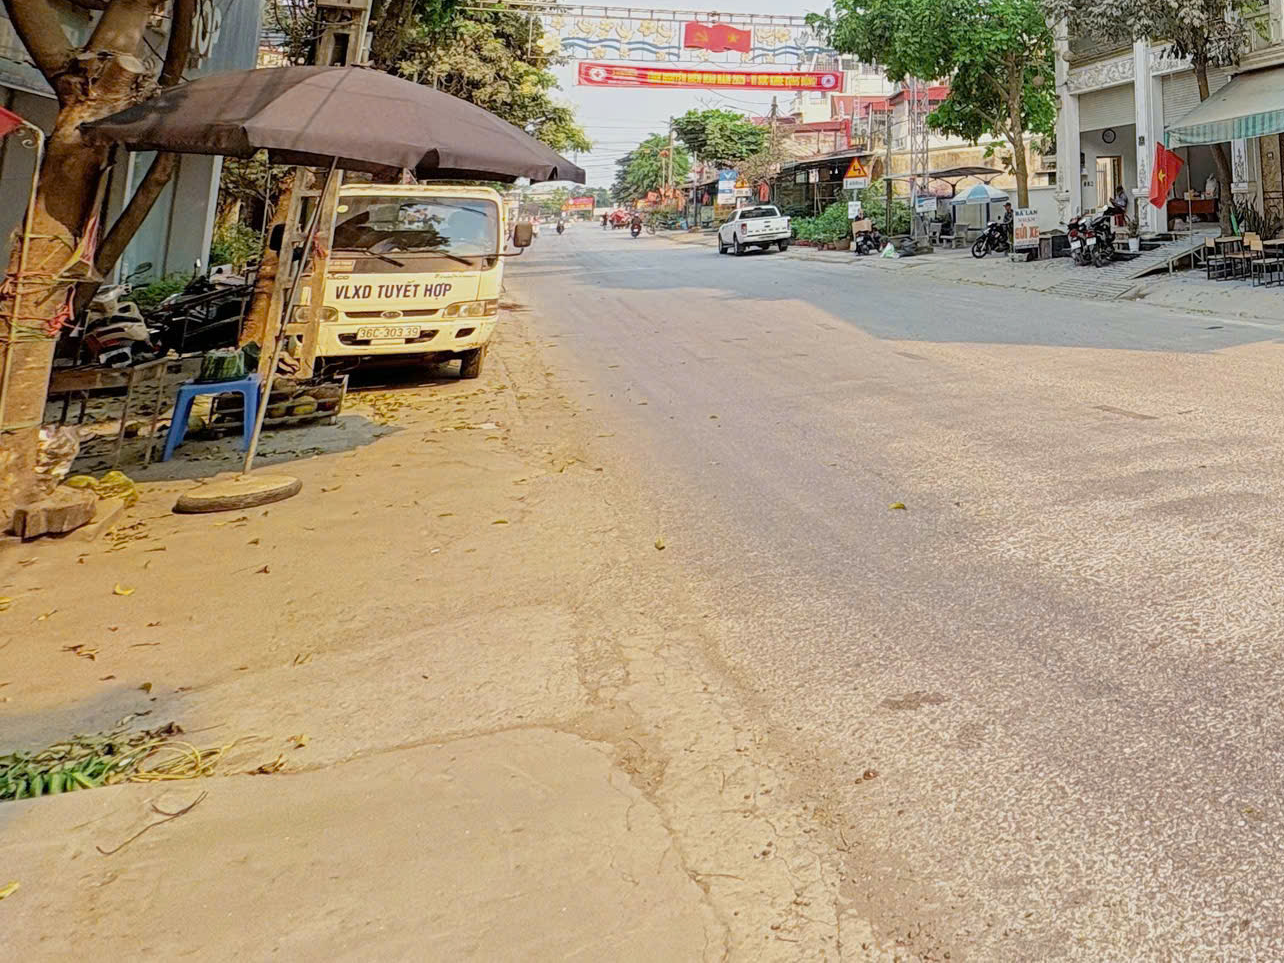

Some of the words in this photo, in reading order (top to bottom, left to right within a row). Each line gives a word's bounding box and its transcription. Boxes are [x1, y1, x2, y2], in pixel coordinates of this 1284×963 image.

[336, 284, 372, 300] VLXD
[378, 279, 420, 299] TUYẾT
[424, 283, 452, 300] HỢP
